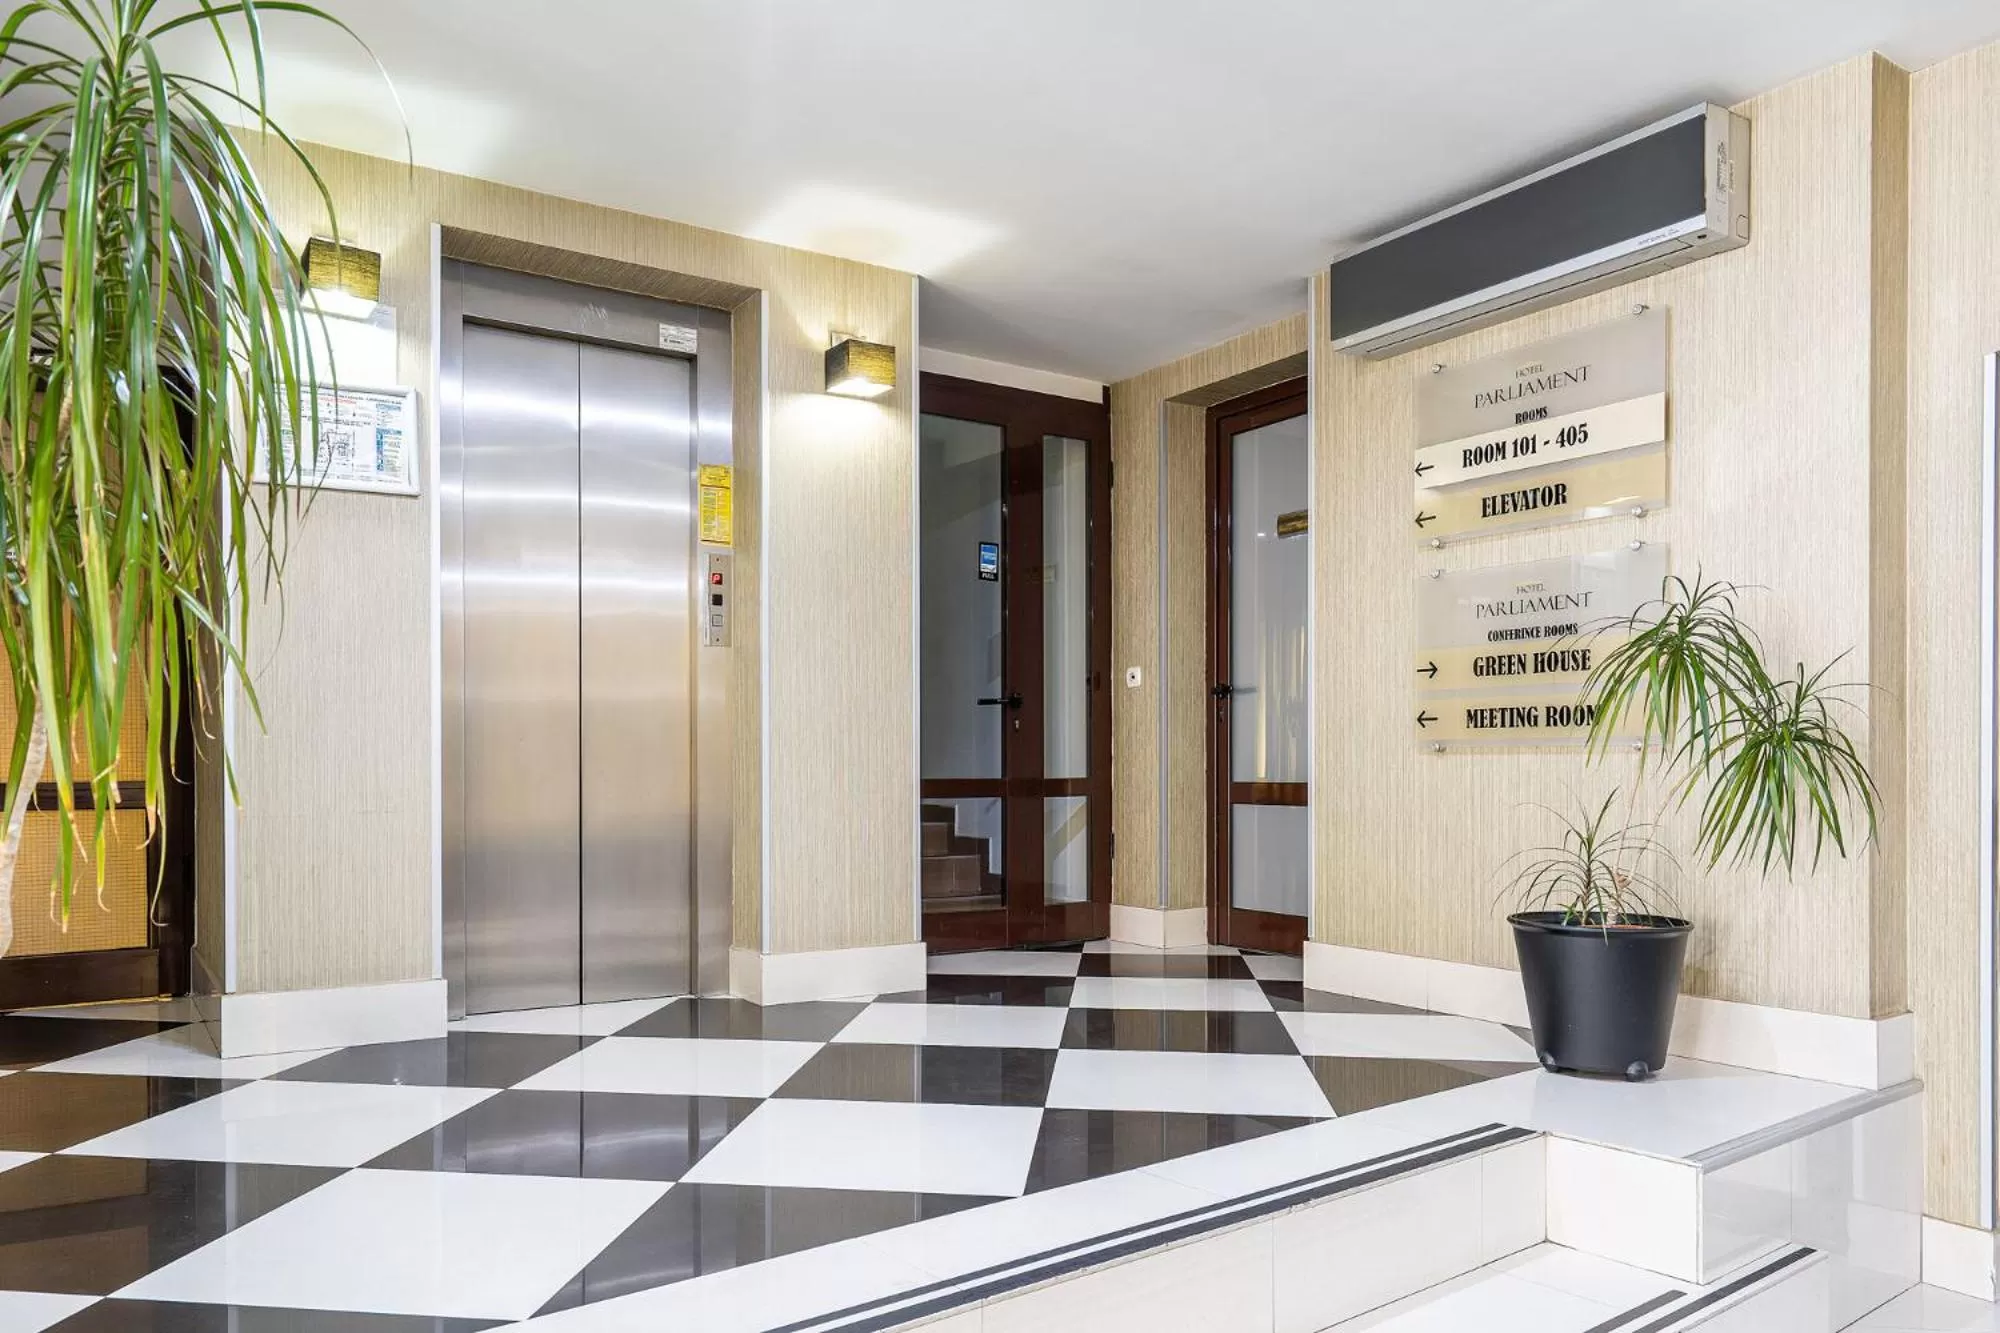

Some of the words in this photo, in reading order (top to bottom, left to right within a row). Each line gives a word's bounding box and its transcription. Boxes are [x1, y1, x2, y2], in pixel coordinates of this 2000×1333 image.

[1516, 364, 1544, 378] HOTEL
[1475, 365, 1591, 409] PARLIAMENT
[1515, 406, 1548, 425] ROOMS
[1462, 441, 1507, 468] ROOM
[1512, 434, 1538, 458] 101
[1555, 423, 1589, 448] 405
[1481, 483, 1568, 519] ELEVATOR
[1516, 583, 1545, 594] HOTEL
[1475, 591, 1593, 619] PARLIAMENT
[1545, 623, 1578, 637] ROOMS
[1473, 653, 1527, 678] GREEN
[1533, 648, 1592, 675] HOUSE
[1466, 706, 1539, 729] MEETING
